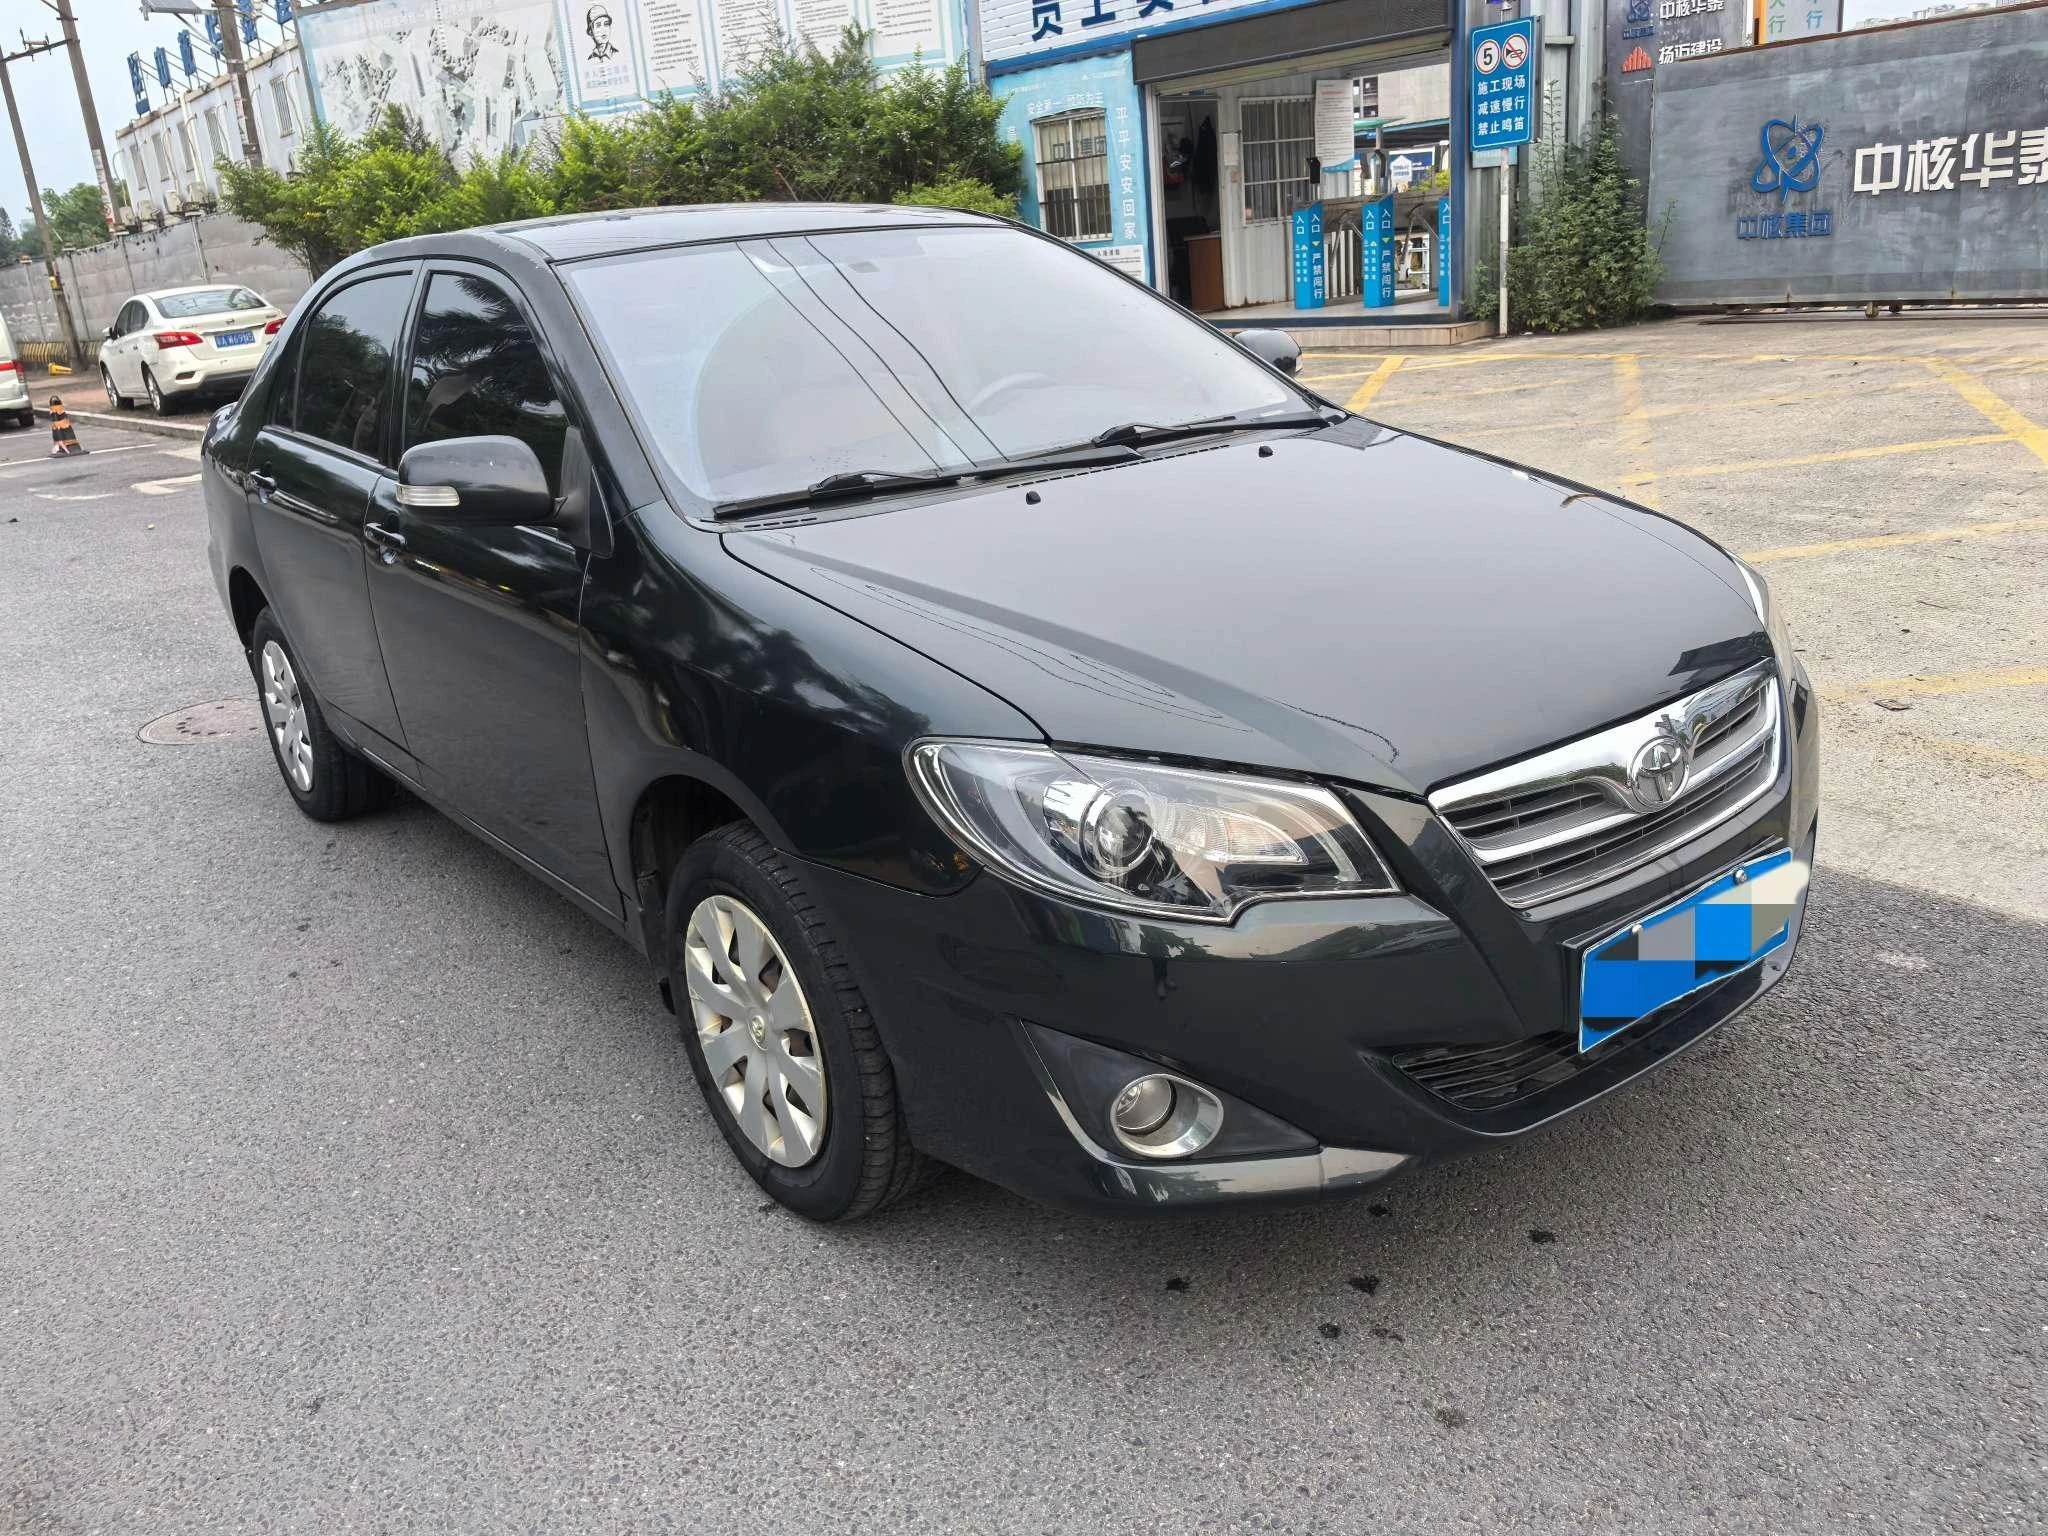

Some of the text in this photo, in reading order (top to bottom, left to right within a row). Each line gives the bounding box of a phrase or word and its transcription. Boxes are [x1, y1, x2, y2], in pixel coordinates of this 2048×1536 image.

[1483, 48, 1493, 66] 5
[1478, 75, 1526, 96] 施工现场
[1478, 96, 1526, 116] 减速慢行
[1478, 116, 1525, 136] 禁止鸣笛
[1116, 106, 1136, 240] 平平安安回家
[1737, 209, 1833, 240] 中核集团
